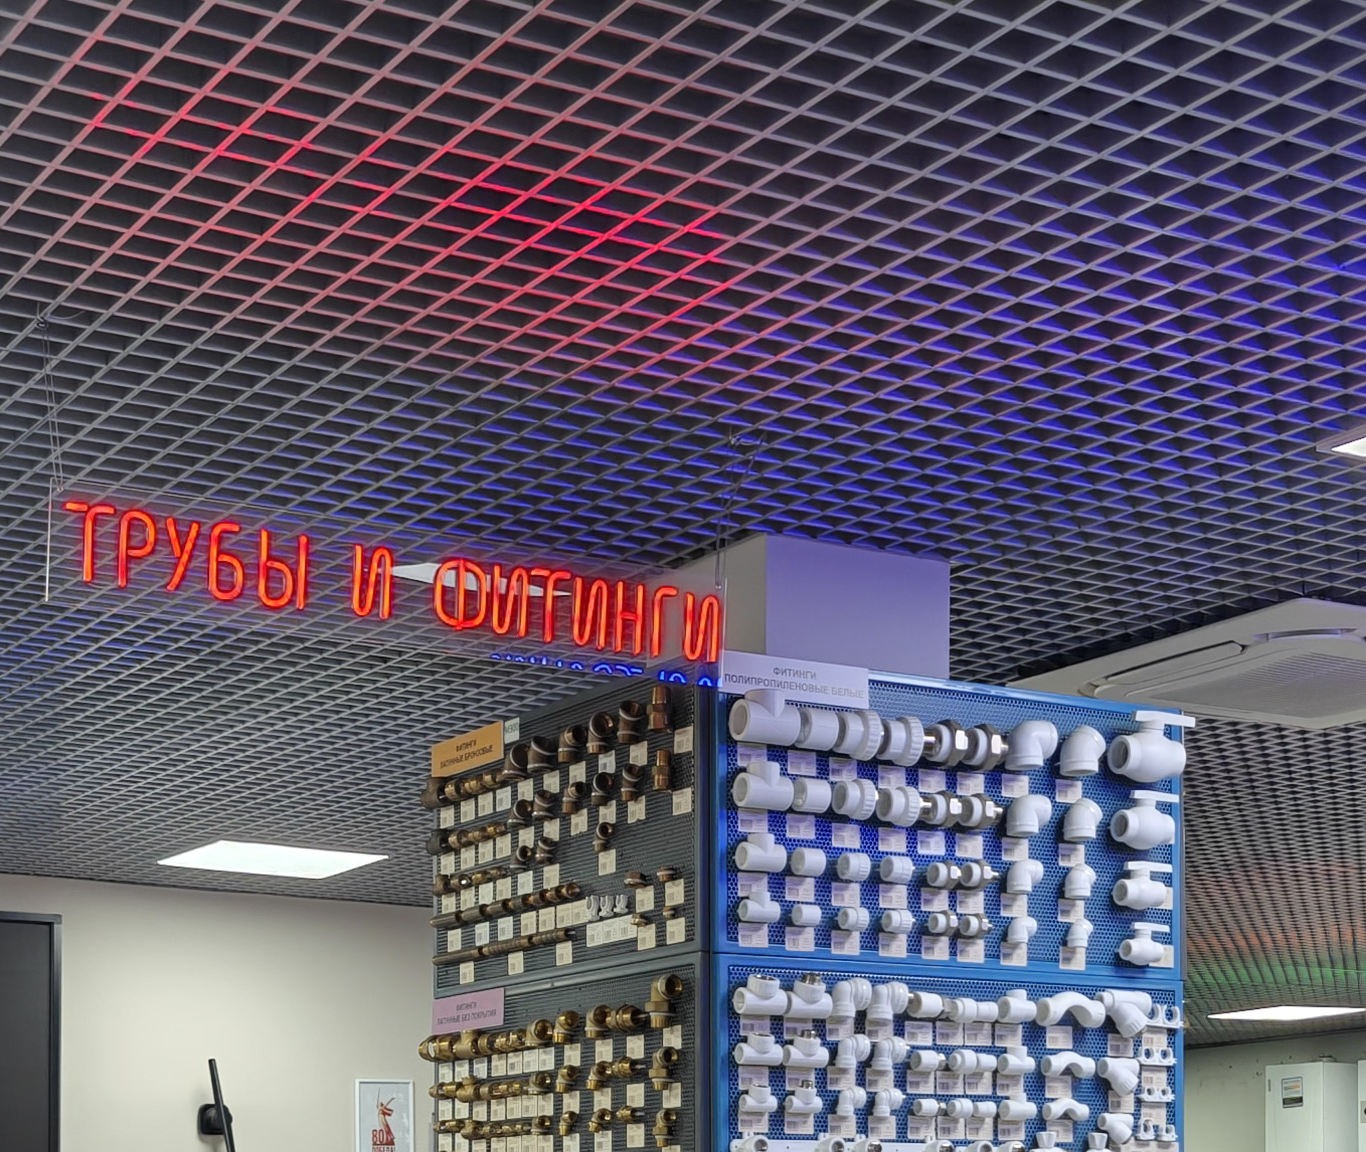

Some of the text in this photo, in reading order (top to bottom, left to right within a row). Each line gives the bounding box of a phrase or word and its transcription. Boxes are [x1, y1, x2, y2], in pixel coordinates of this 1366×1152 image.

[63, 502, 721, 664] ТРУБЫ И ФИТИНГИ
[773, 667, 817, 680] ФИТИНГИ
[724, 673, 865, 699] ПОЛИПРОПИЛЕНОВЫЕ БЕЛЫЕ
[372, 1129, 384, 1145] 80
